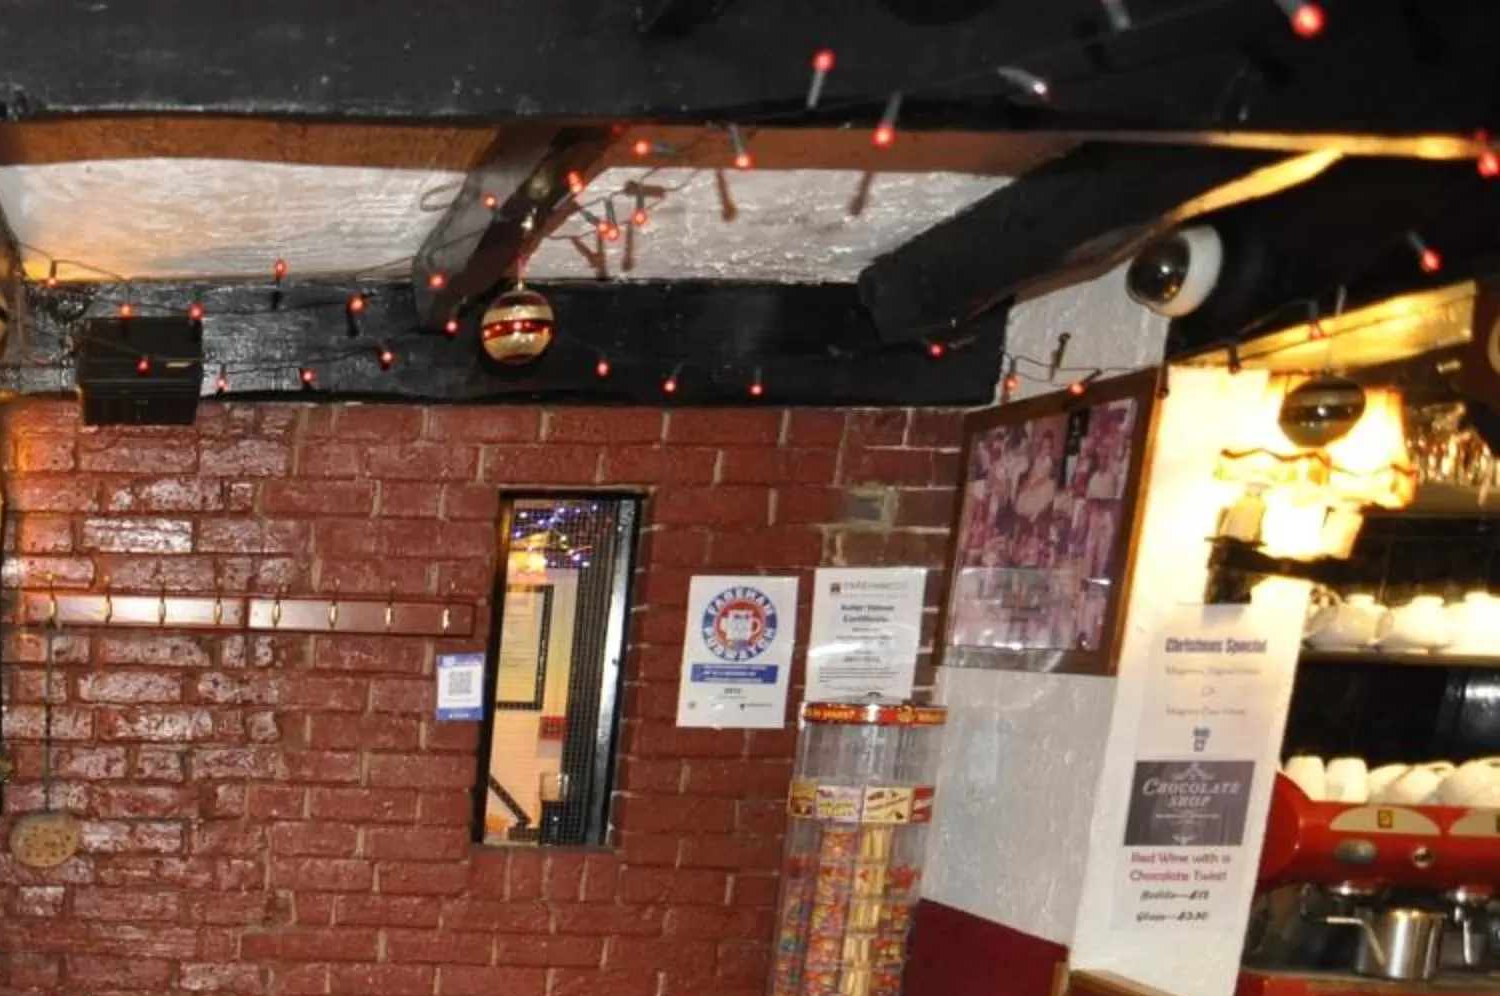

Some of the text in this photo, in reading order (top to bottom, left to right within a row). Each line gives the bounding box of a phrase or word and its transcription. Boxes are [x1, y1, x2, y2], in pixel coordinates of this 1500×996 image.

[1165, 637, 1268, 655] Christmas Special
[1142, 777, 1241, 796] CHOCOLATE
[1166, 796, 1212, 808] SHOP
[1131, 852, 1156, 864] Red
[1158, 852, 1189, 864] Wine
[1192, 853, 1218, 864] with
[1130, 869, 1189, 881] Chocolate
